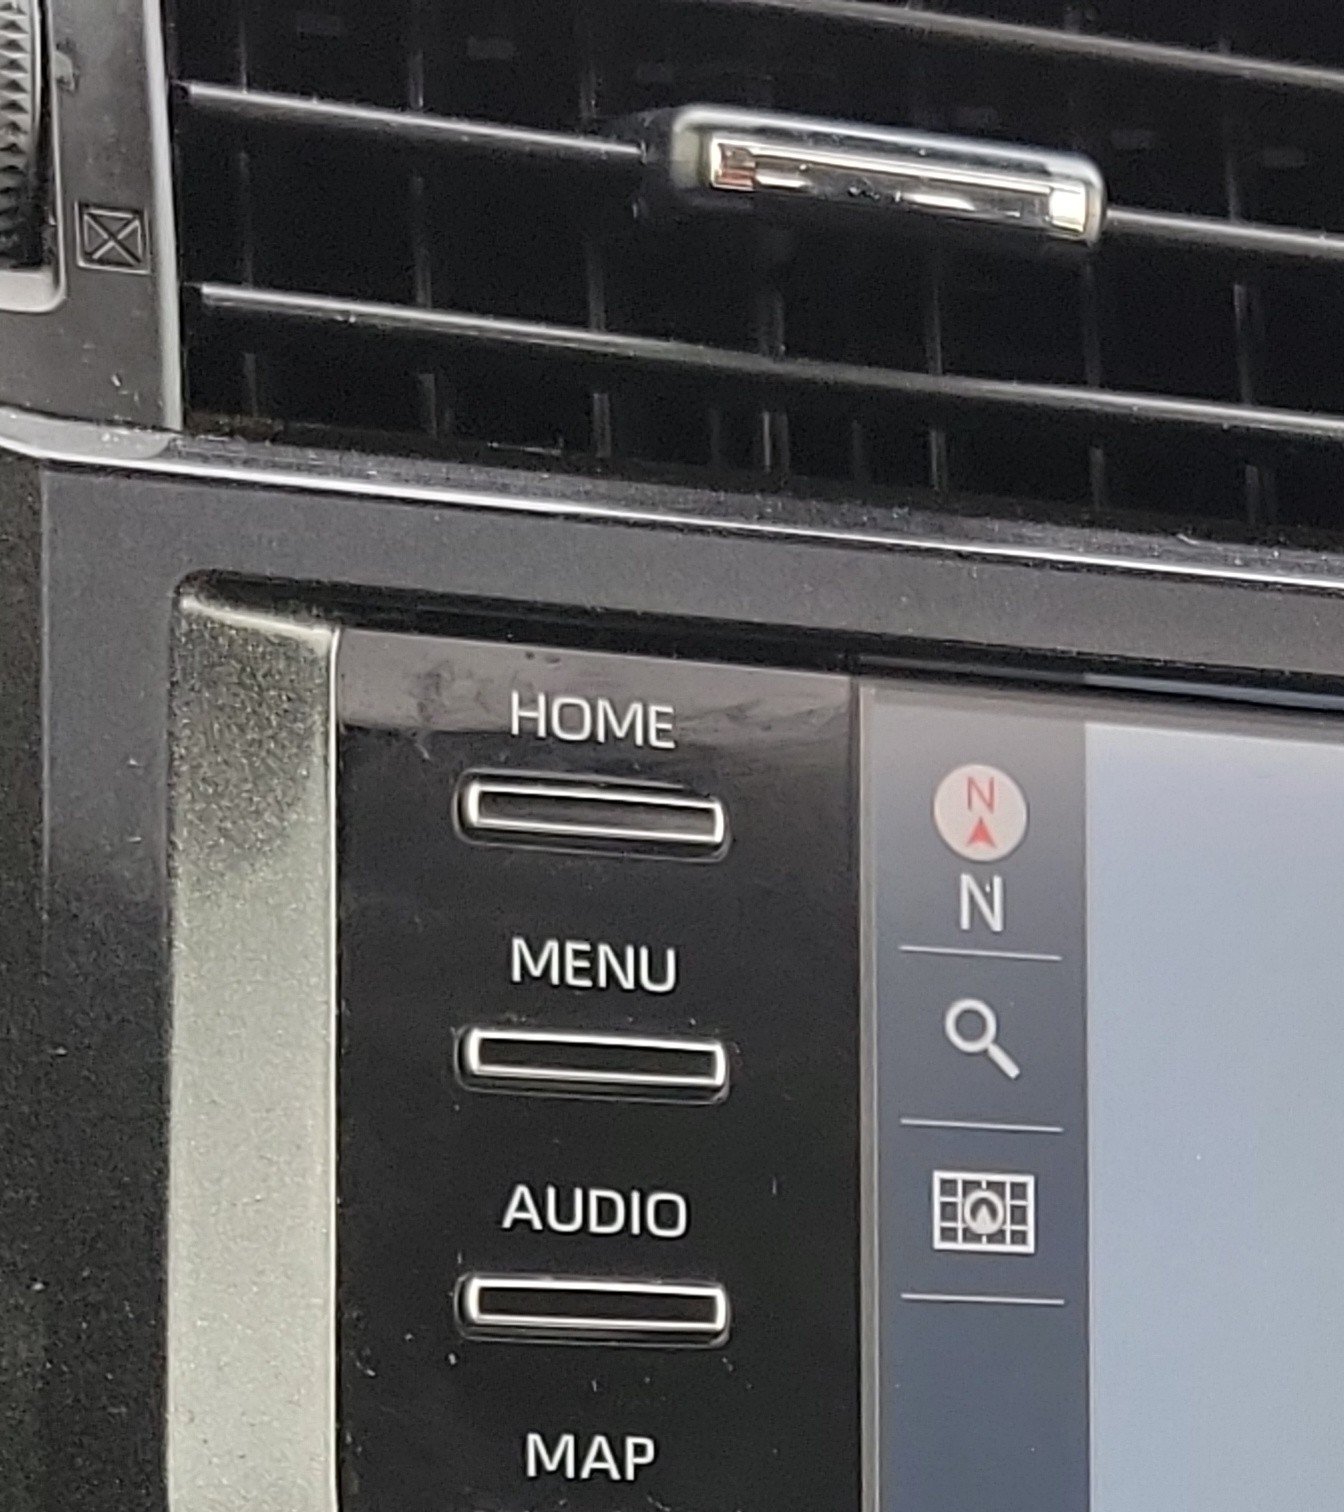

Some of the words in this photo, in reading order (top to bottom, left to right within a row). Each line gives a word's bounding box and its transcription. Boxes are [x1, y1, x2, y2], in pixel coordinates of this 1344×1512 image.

[509, 691, 676, 749] HOME
[966, 776, 995, 812] N
[959, 873, 1003, 932] N
[510, 937, 677, 993] MENU
[501, 1185, 690, 1239] AUDIO
[525, 1433, 656, 1482] MAP
